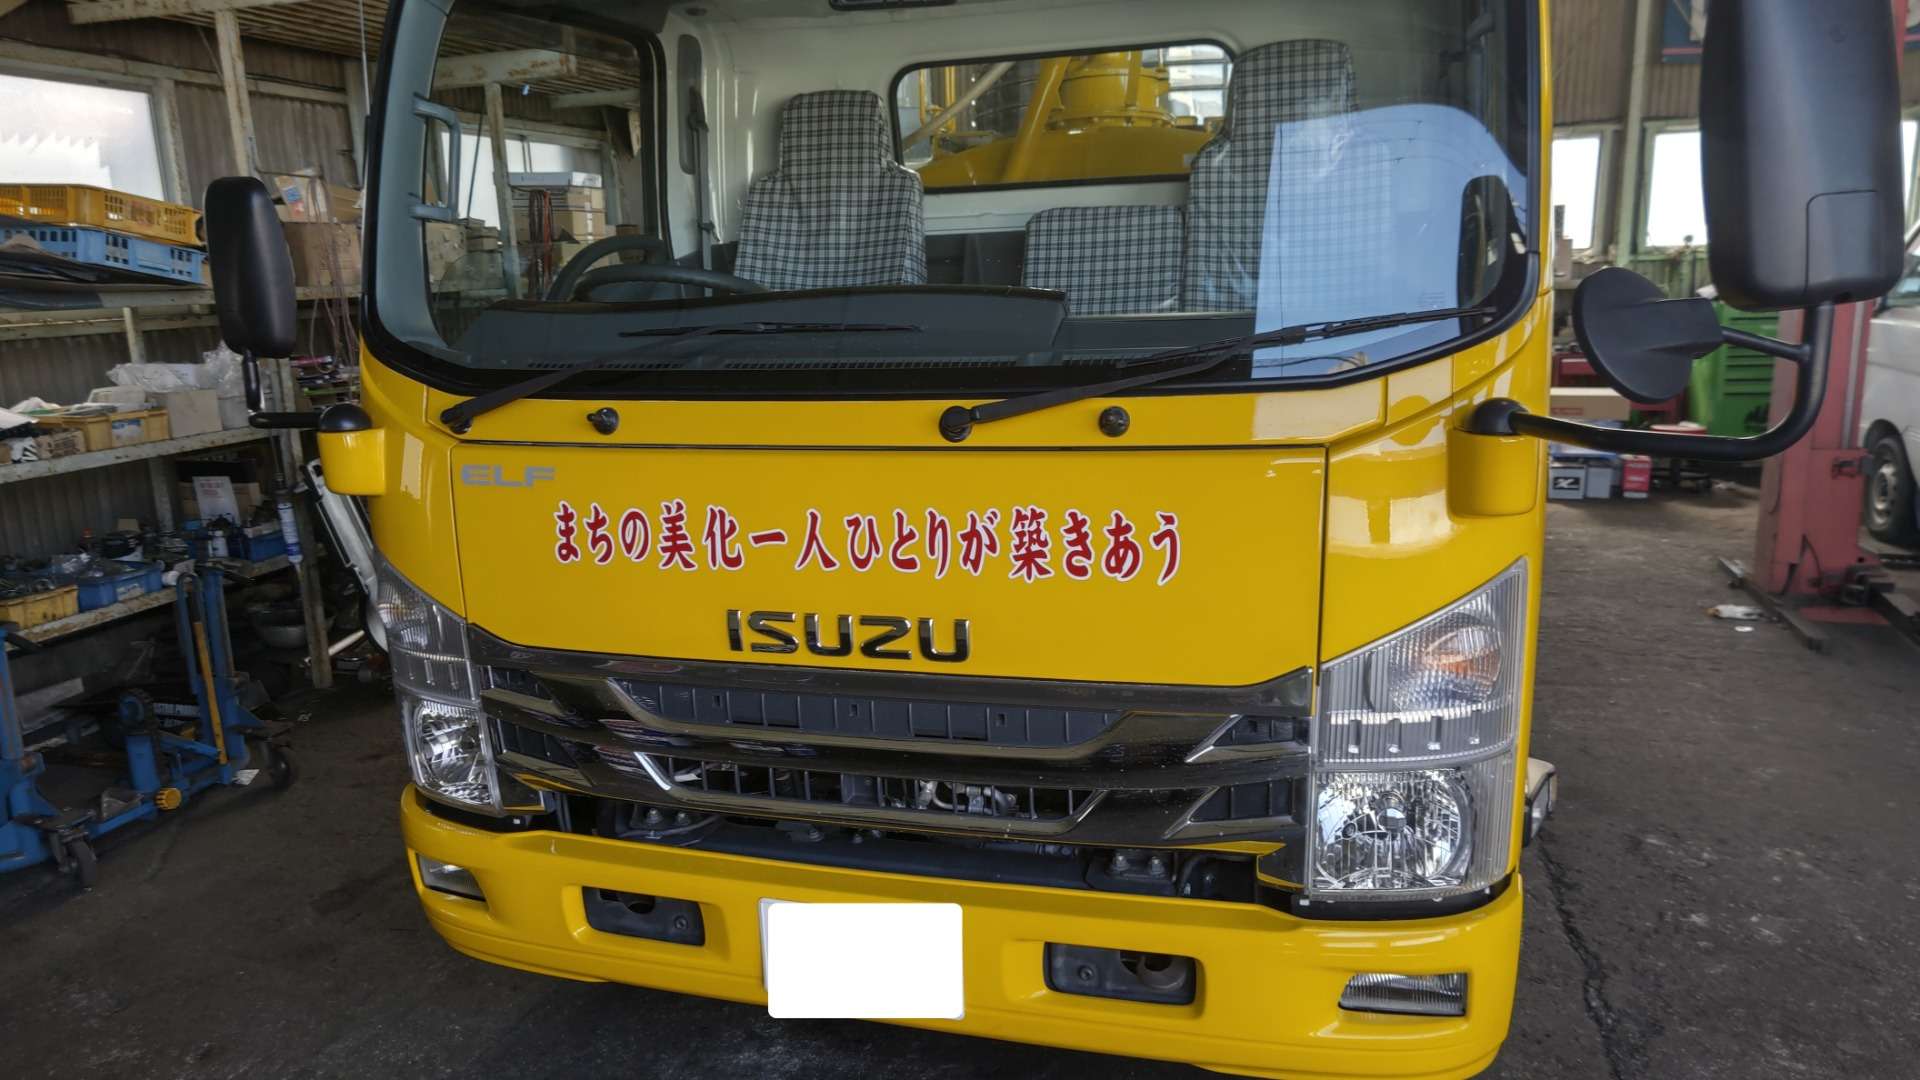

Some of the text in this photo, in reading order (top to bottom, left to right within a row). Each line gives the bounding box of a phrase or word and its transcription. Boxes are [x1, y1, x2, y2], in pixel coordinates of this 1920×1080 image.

[462, 464, 556, 487] ELF
[553, 498, 1181, 586] まちの美化一人ひとりが築きあう
[727, 609, 970, 663] ISUZU
